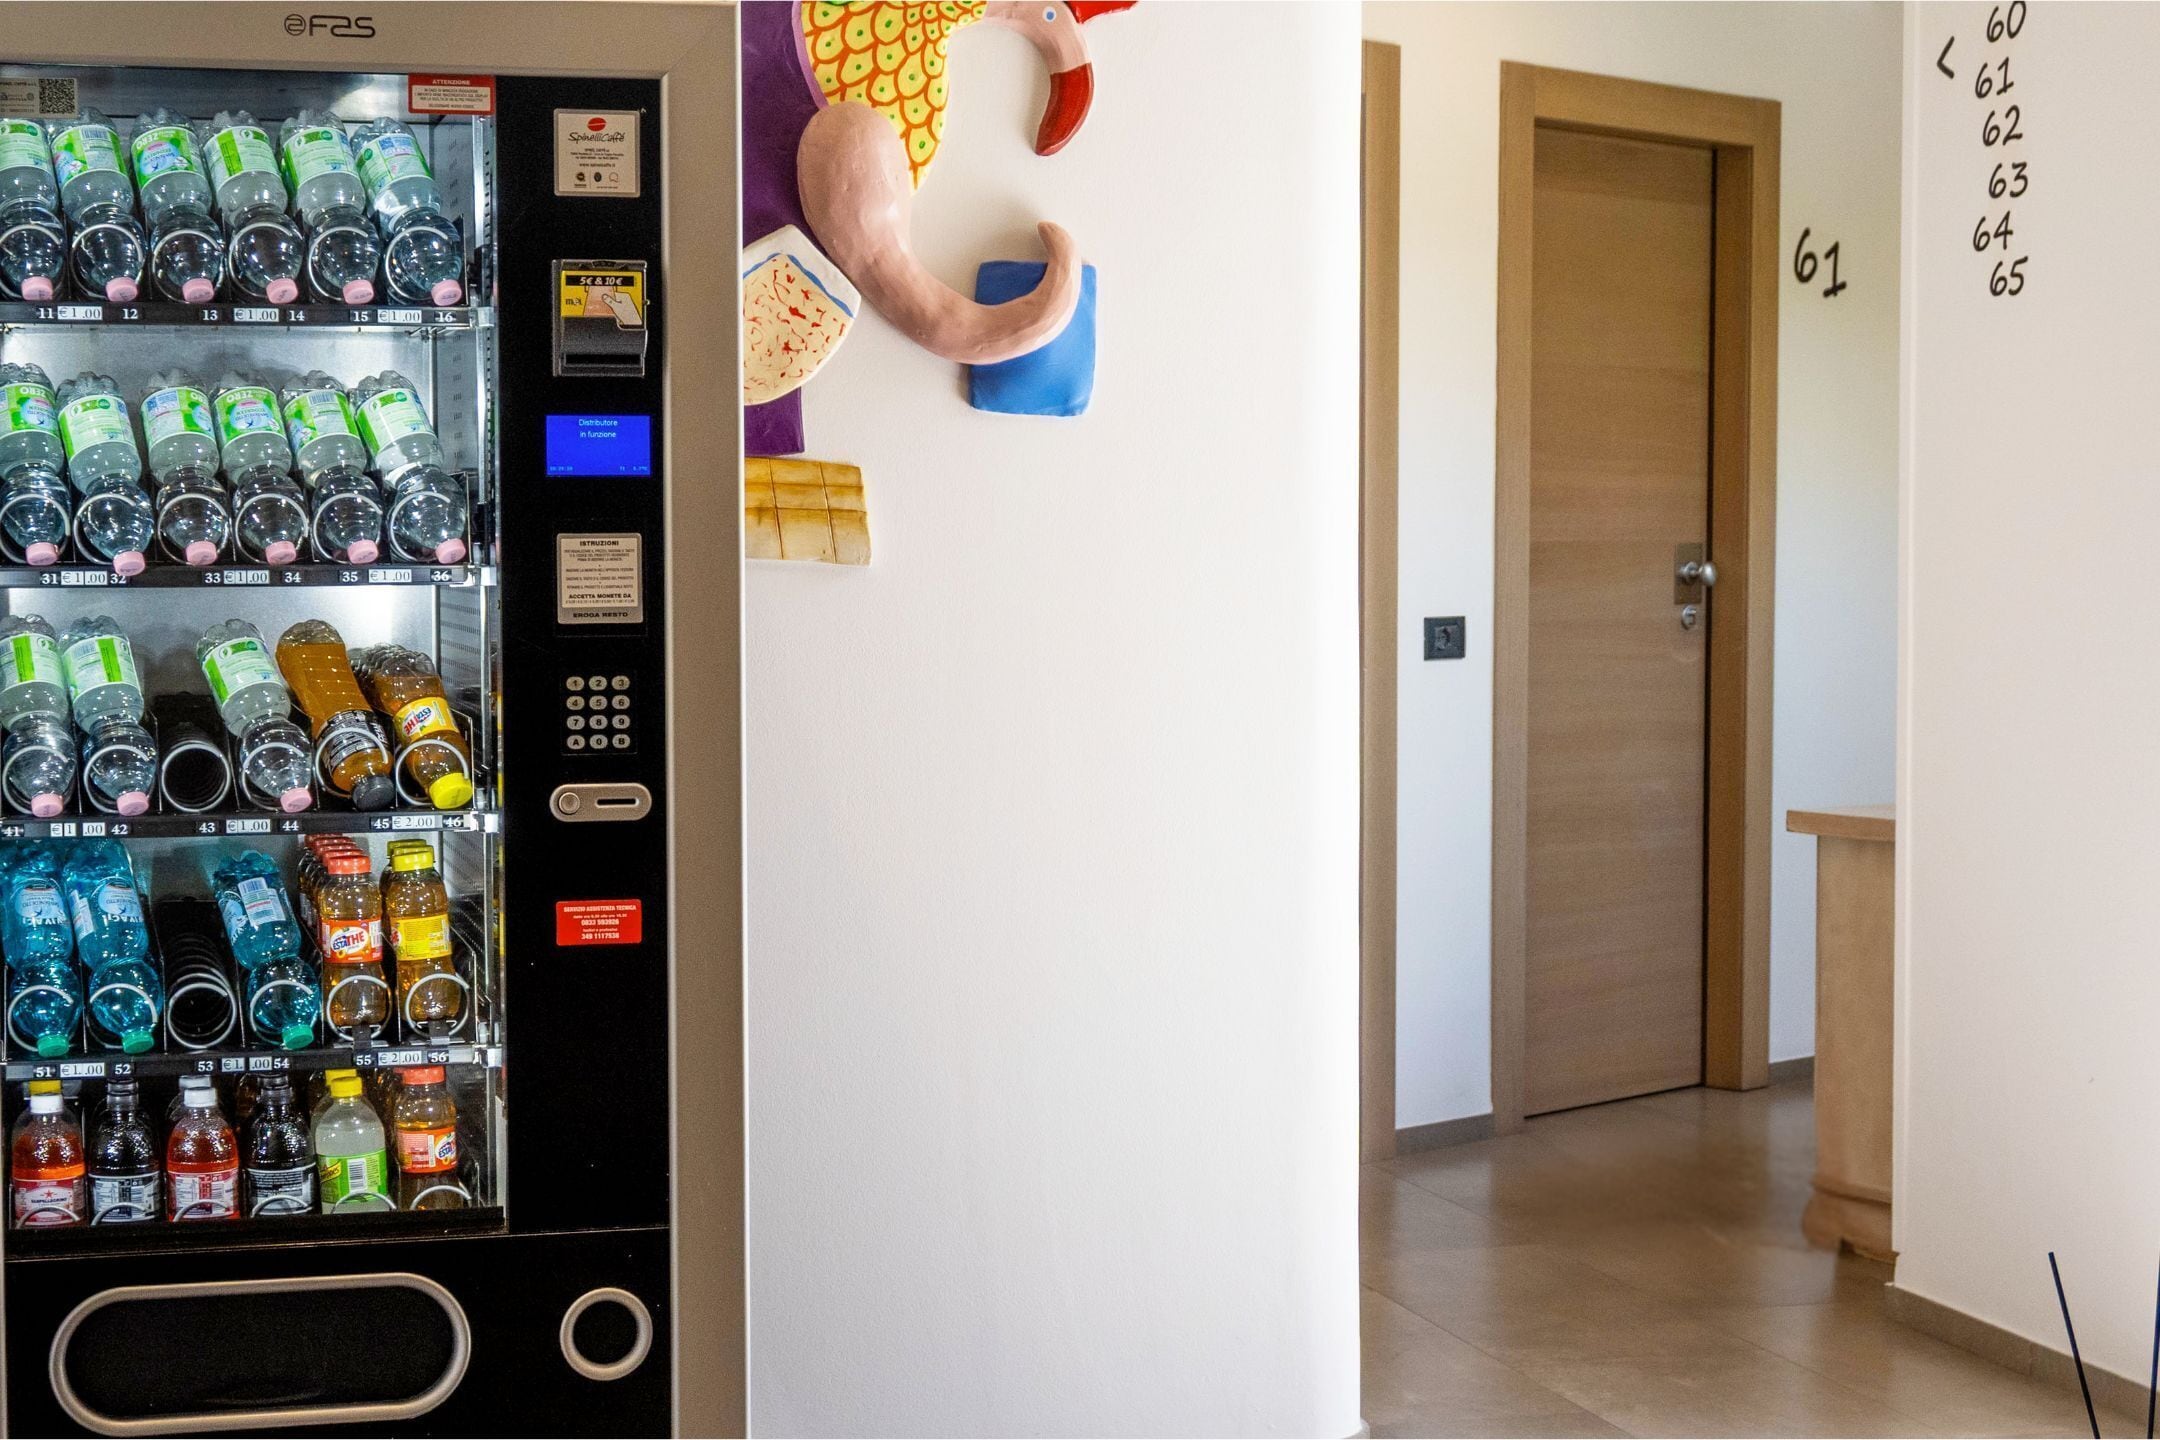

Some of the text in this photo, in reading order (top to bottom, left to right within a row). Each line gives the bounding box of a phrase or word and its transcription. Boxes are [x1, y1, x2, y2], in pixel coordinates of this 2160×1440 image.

[1986, 0, 2027, 43] 60
[1974, 56, 2014, 99] 61
[1982, 104, 2023, 147] 62
[1988, 161, 2028, 199] 63
[1972, 210, 2014, 252] 64
[1793, 227, 1847, 298] 61
[1989, 255, 2029, 297] 65
[38, 307, 54, 319] 11
[122, 308, 138, 320] 12
[202, 309, 218, 321] 13
[288, 310, 305, 322] 14
[353, 310, 369, 322] 15
[437, 311, 454, 323] 16
[41, 573, 59, 585] 31
[110, 573, 127, 584] 32
[204, 572, 221, 584] 33
[284, 571, 301, 583] 34
[342, 571, 358, 582] 35
[433, 570, 450, 581] 36
[595, 679, 602, 687] 2
[618, 679, 624, 687] 3
[572, 699, 578, 707] 4
[595, 699, 602, 707] 5
[573, 719, 579, 727] 7
[618, 718, 624, 726] 9
[572, 738, 580, 746] A
[618, 737, 625, 745] B
[4, 825, 22, 837] 41
[111, 824, 128, 835] 42
[199, 821, 216, 833] 43
[282, 820, 299, 831] 44
[374, 817, 390, 829] 45
[445, 816, 461, 827] 46
[36, 1066, 52, 1078] 51
[114, 1063, 131, 1074] 52
[197, 1060, 214, 1072] 53
[273, 1058, 290, 1069] 54
[355, 1054, 372, 1066] 55
[430, 1051, 447, 1062] 56
